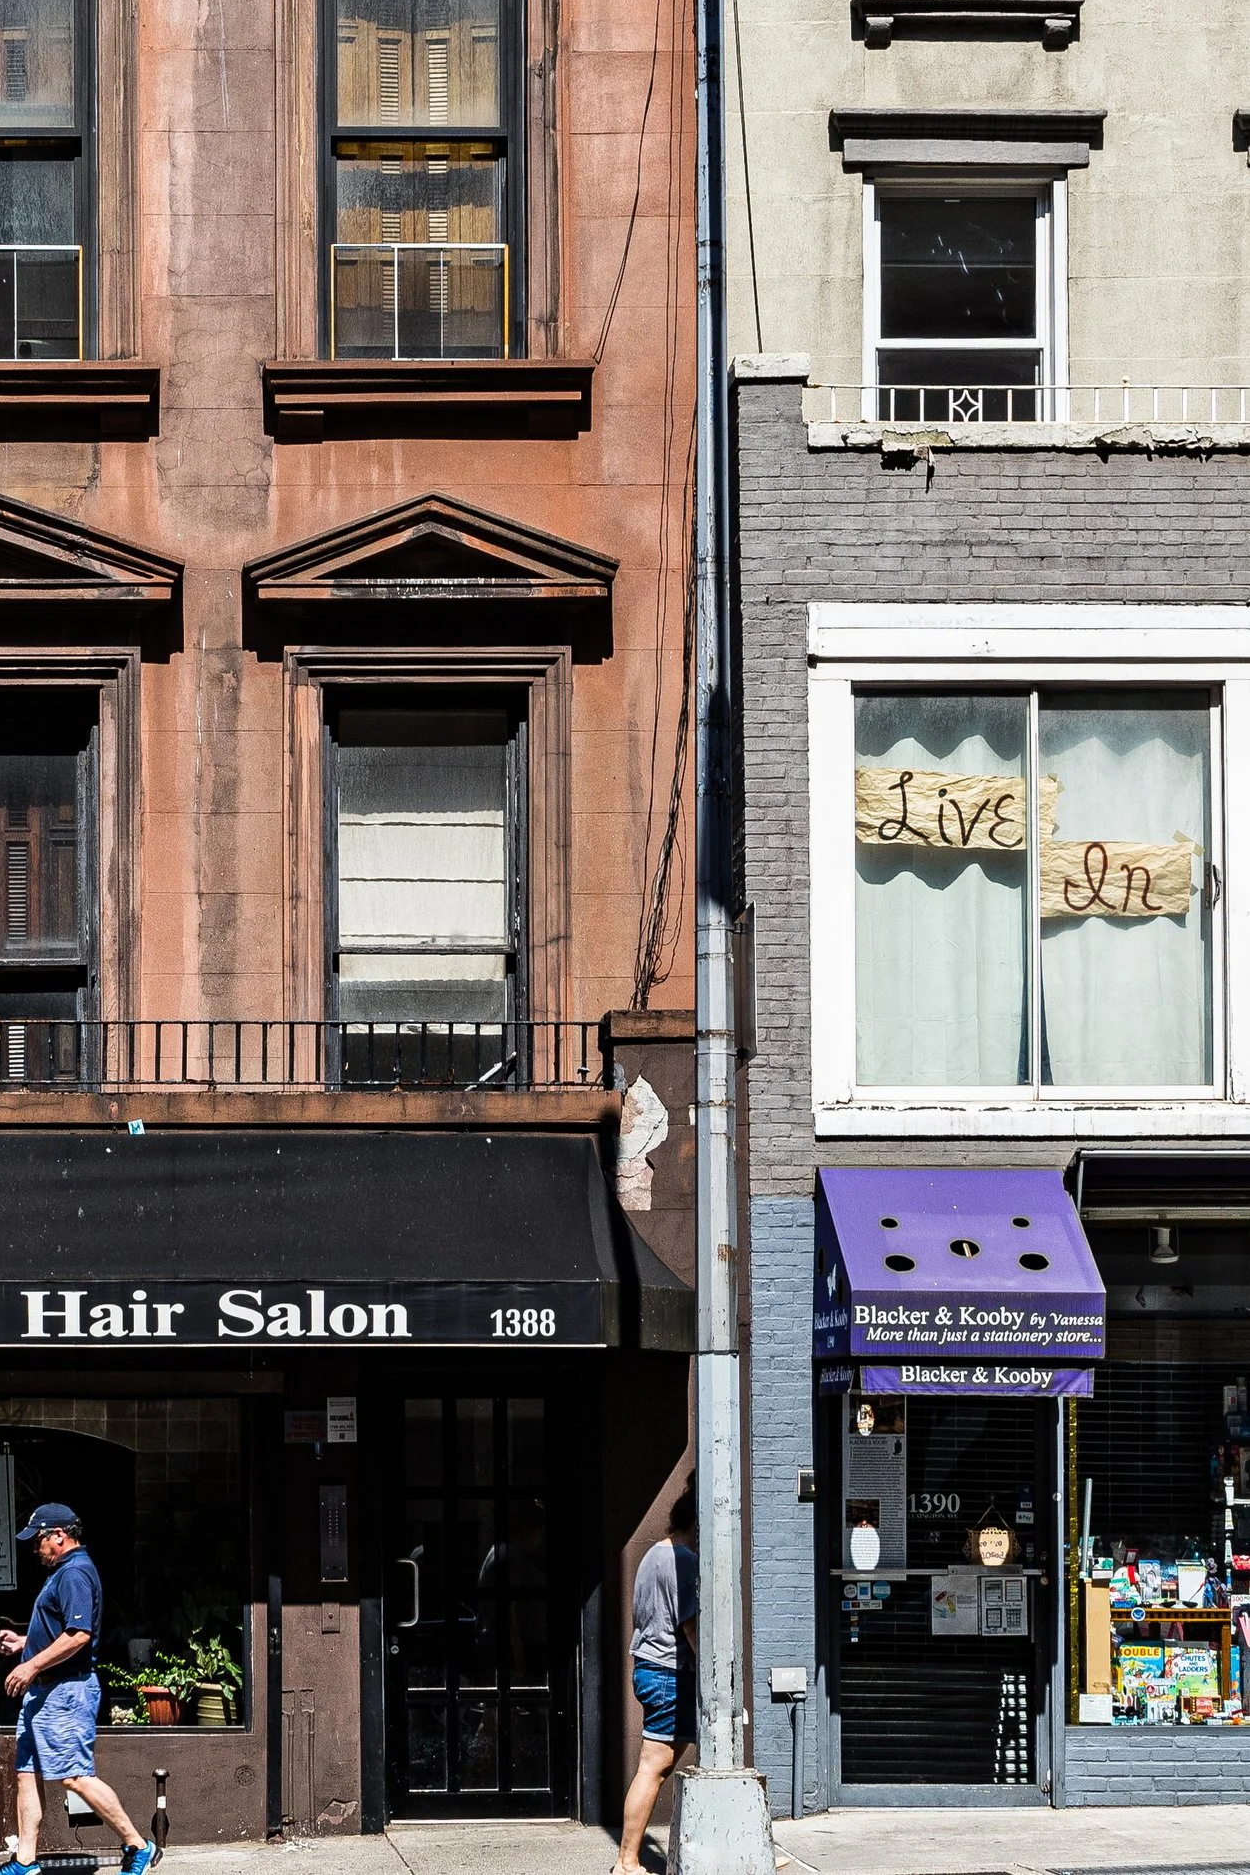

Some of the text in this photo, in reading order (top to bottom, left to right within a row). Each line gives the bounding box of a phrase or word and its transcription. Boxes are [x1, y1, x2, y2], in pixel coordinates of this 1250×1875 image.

[1064, 841, 1162, 913] In
[19, 1289, 185, 1338] Hair
[217, 1288, 413, 1338] Salon
[490, 1308, 556, 1337] 1388
[854, 1305, 1104, 1330] Blacker & Kooby by Vanessa
[866, 1327, 1103, 1346] More than just a stationery store...
[900, 1365, 1053, 1388] Blacker & Kooby
[907, 1493, 961, 1513] 1390
[1121, 1647, 1160, 1657] OUBLE
